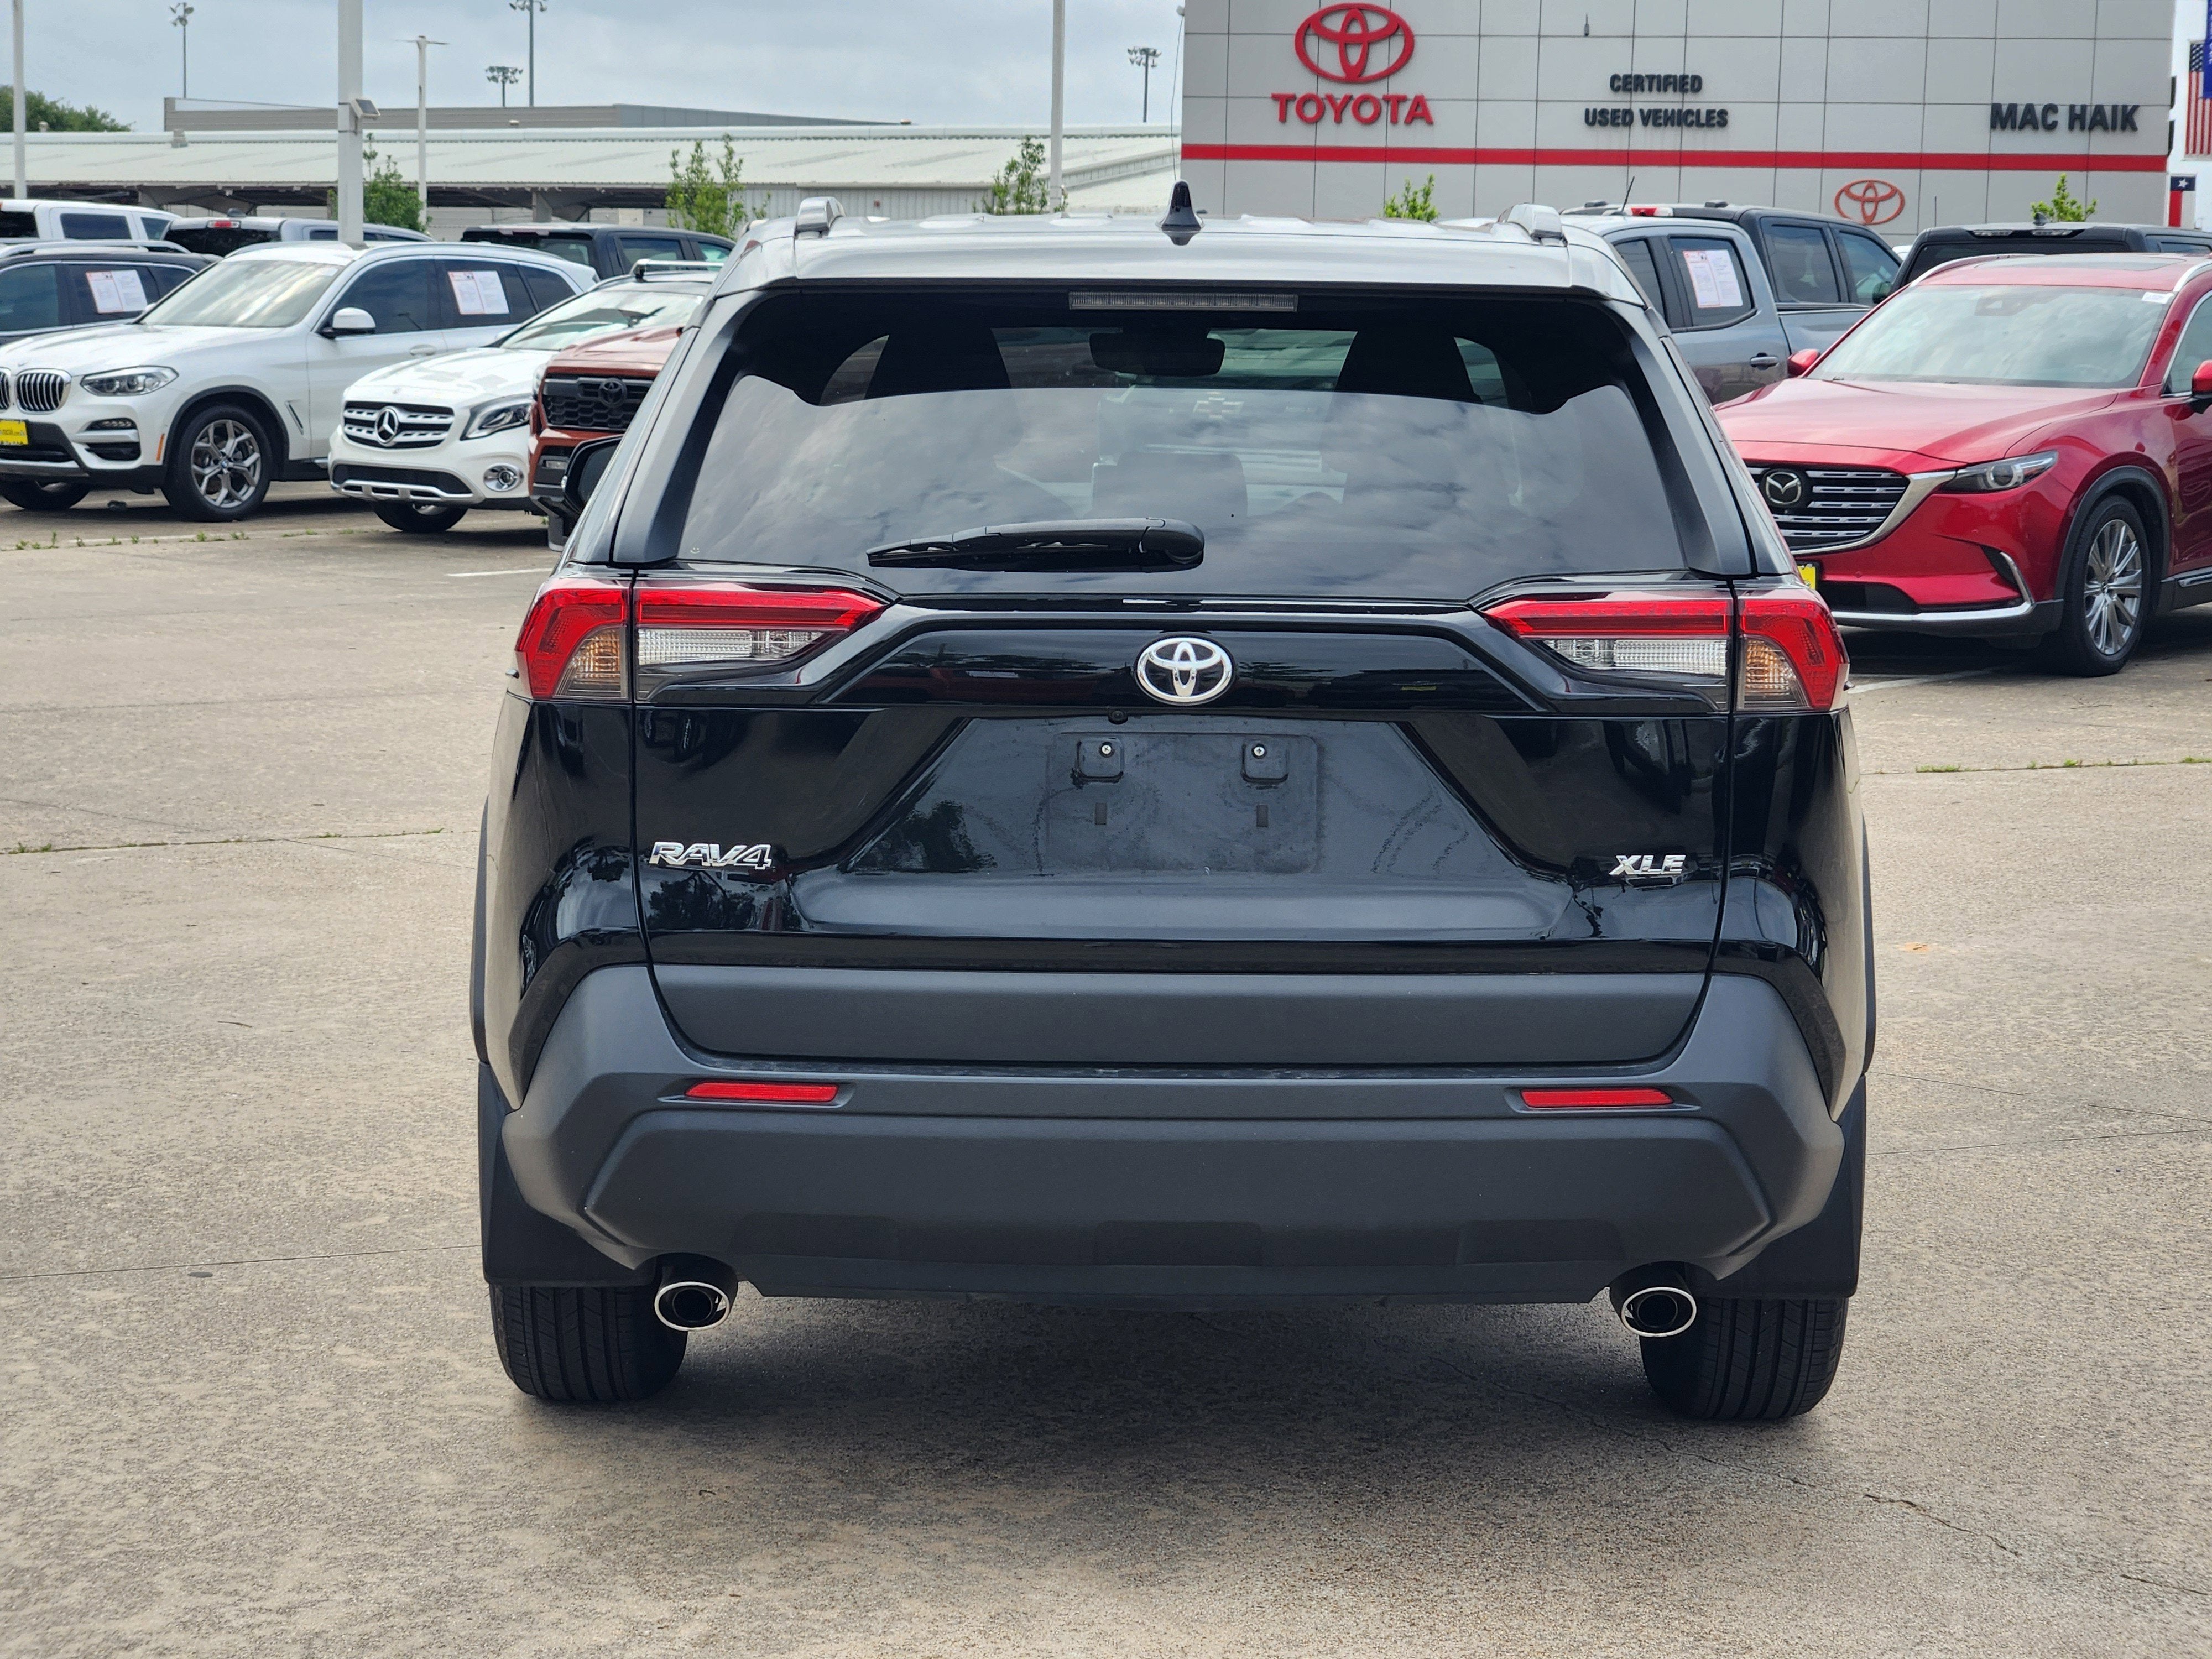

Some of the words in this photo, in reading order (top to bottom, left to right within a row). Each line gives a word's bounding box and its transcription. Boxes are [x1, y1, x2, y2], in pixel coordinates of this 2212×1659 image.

[1610, 74, 1703, 93] CERTIFIED
[1271, 93, 1433, 124] TOYOTA
[1585, 108, 1634, 127] USED
[1640, 109, 1729, 128] VEHICLES
[1991, 103, 2059, 131] MAC
[2068, 104, 2140, 132] HAIK
[649, 841, 772, 870] RAV4
[1609, 854, 1686, 875] XLE
